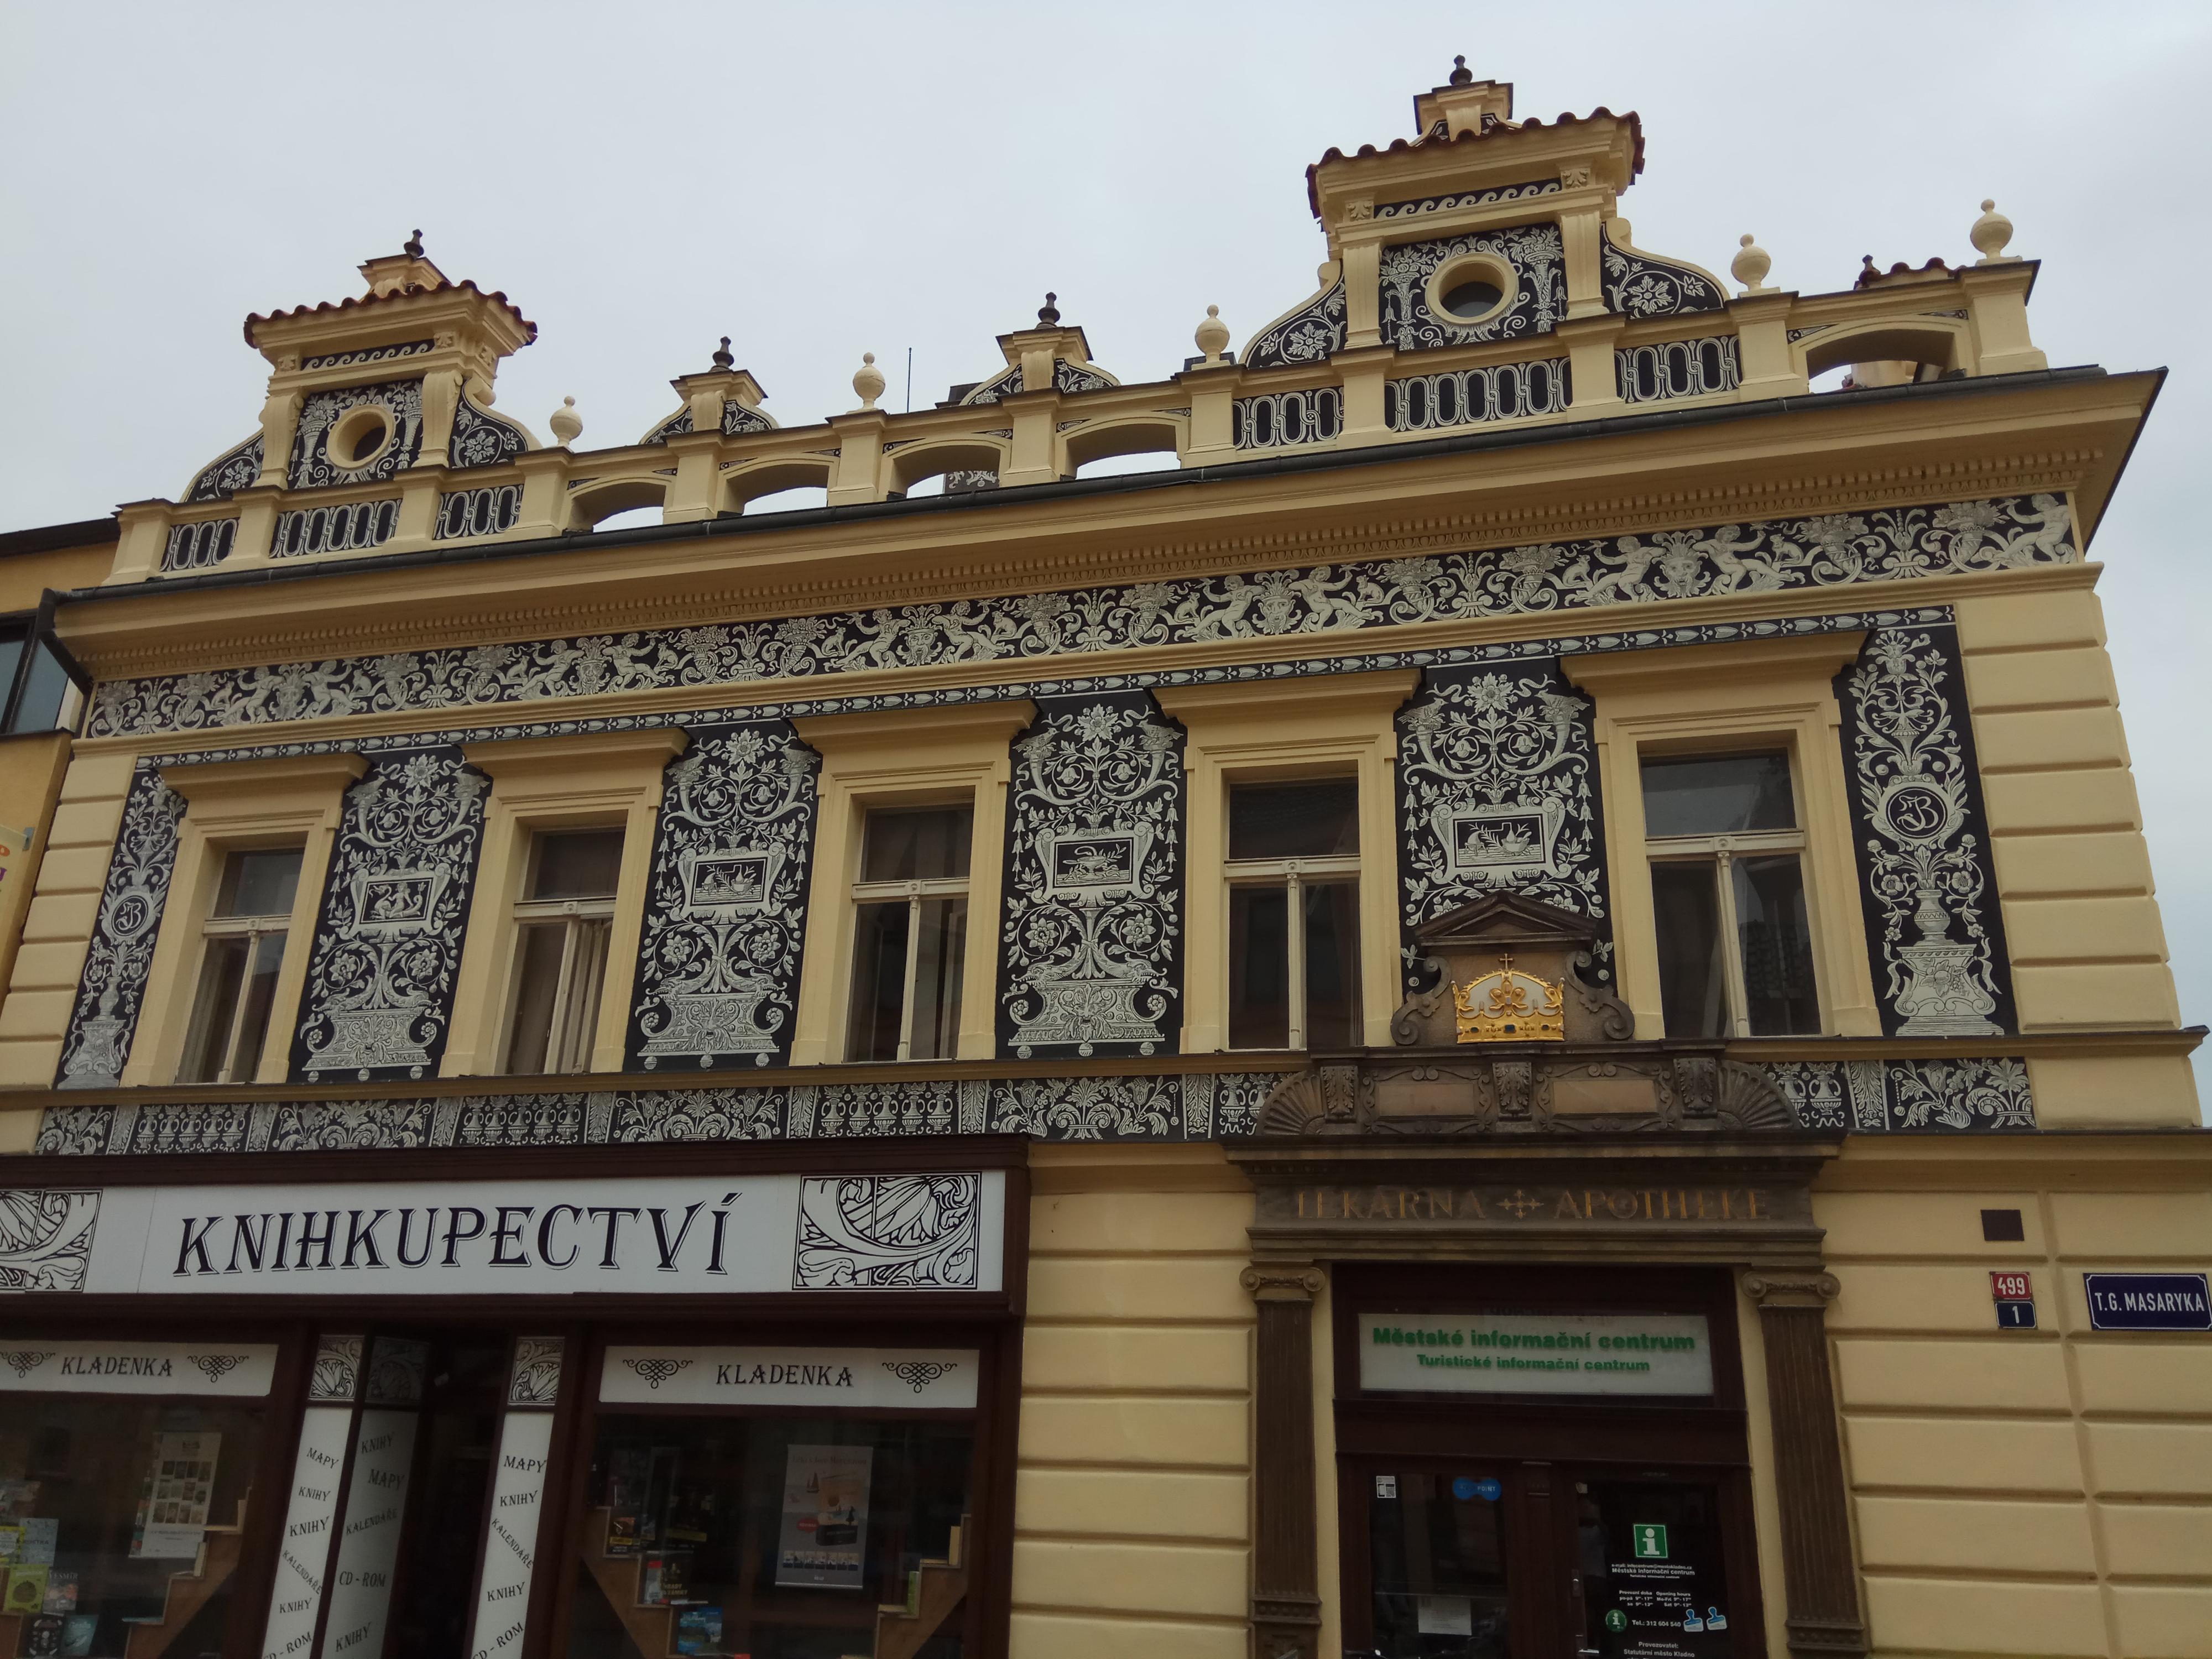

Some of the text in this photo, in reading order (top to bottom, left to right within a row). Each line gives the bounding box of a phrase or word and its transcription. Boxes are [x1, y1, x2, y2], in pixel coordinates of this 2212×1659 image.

[1554, 1189, 1770, 1219] APOTHEKE
[173, 1192, 742, 1276] KNIHKUPECTVÍ
[1997, 1277, 2026, 1295] 499
[2124, 1292, 2205, 1312] MASARYKA
[2011, 1305, 2020, 1324] 1
[1373, 1327, 1695, 1350] Městské informační centrum
[61, 1356, 173, 1376] KLADENKA
[1416, 1354, 1650, 1371] Turistické informační centrum
[716, 1364, 853, 1387] KLADENKA
[362, 1436, 394, 1453] KNIHY
[306, 1447, 339, 1469] MAPY
[504, 1455, 546, 1473] MAPY
[368, 1469, 405, 1490] MAPY
[299, 1486, 331, 1501] KNIHY
[500, 1490, 538, 1506] KNIHY
[290, 1516, 330, 1537] KNIHY
[339, 1571, 353, 1585] CD
[362, 1572, 387, 1588] ROM
[487, 1582, 525, 1601] KNIHY
[279, 1598, 312, 1614] KNIHY
[286, 1632, 312, 1653] ROM
[335, 1621, 372, 1652] KNIHY
[497, 1621, 524, 1647] ROM
